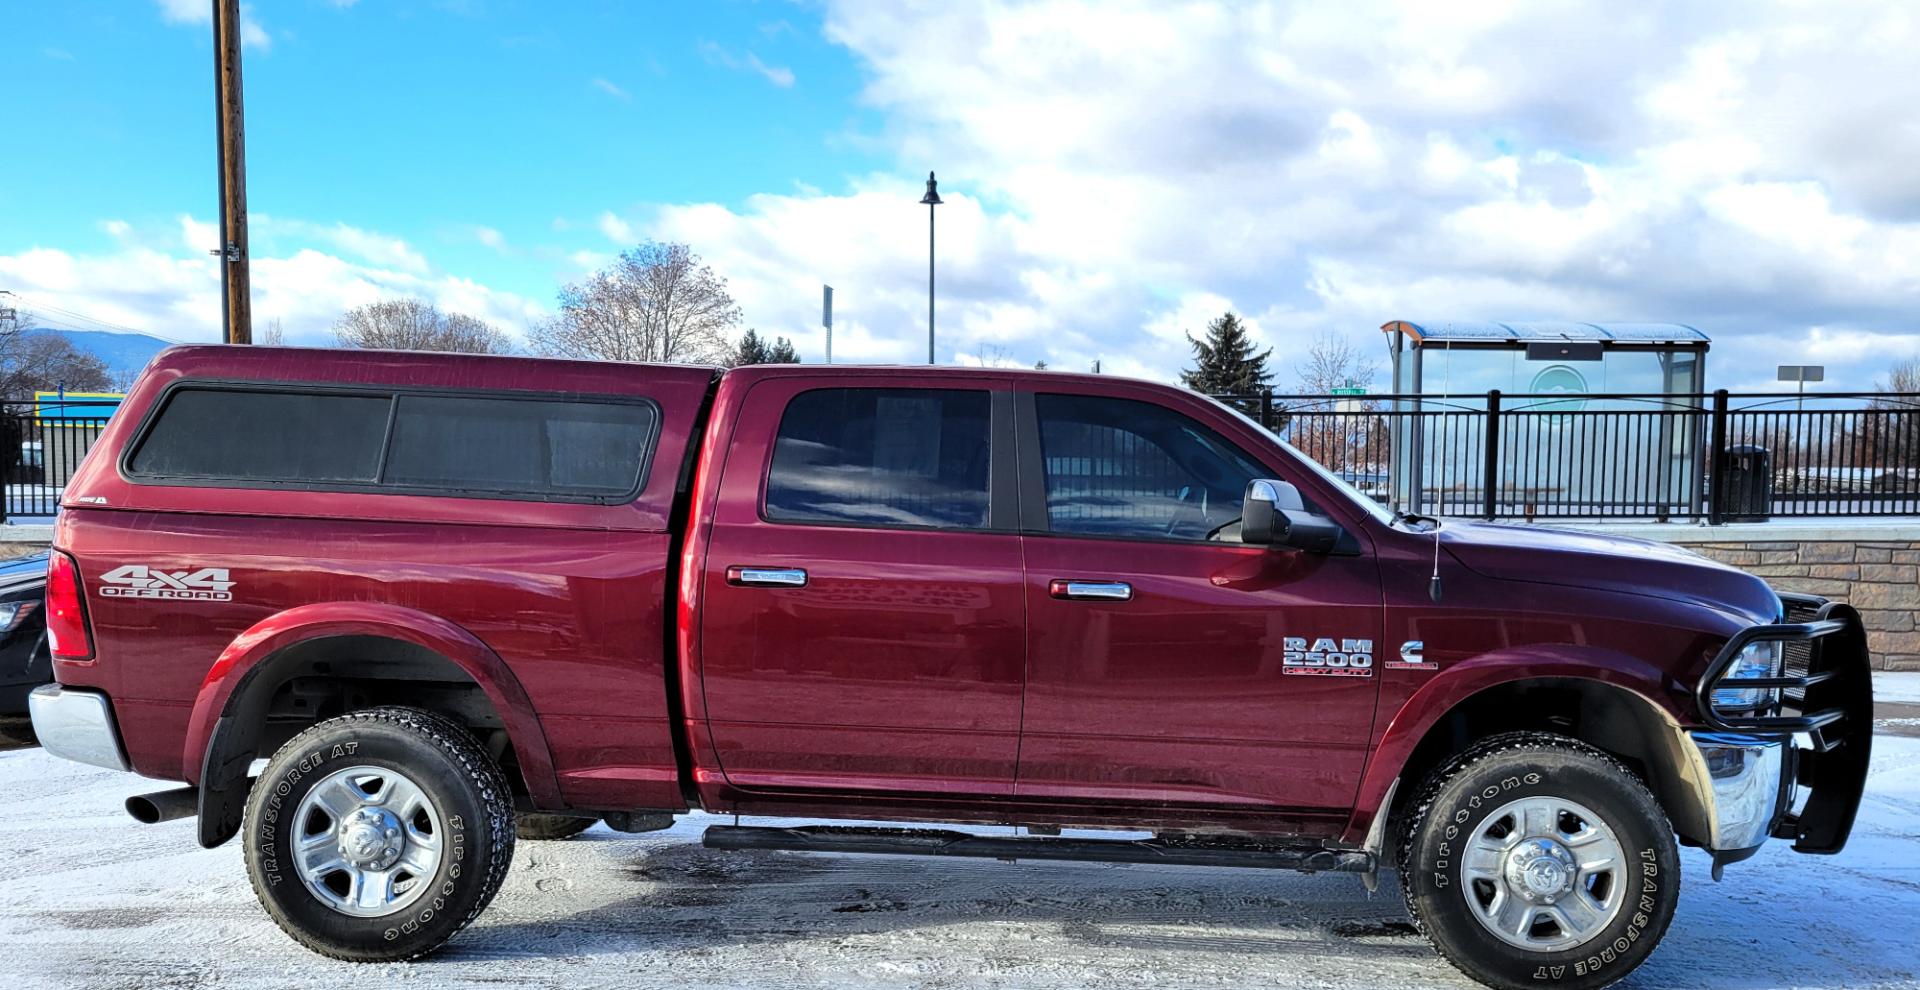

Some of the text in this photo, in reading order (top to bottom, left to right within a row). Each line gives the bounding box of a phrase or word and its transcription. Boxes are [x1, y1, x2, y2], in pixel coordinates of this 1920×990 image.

[102, 588, 230, 600] OFF ROAD
[1283, 637, 1373, 653] RAM
[1283, 651, 1372, 667] 2500
[260, 741, 359, 885] TRANSFORCE AT
[1435, 772, 1543, 889] Firestone
[384, 814, 465, 941] Firestone
[1533, 848, 1658, 980] TRANSFORCE AT
